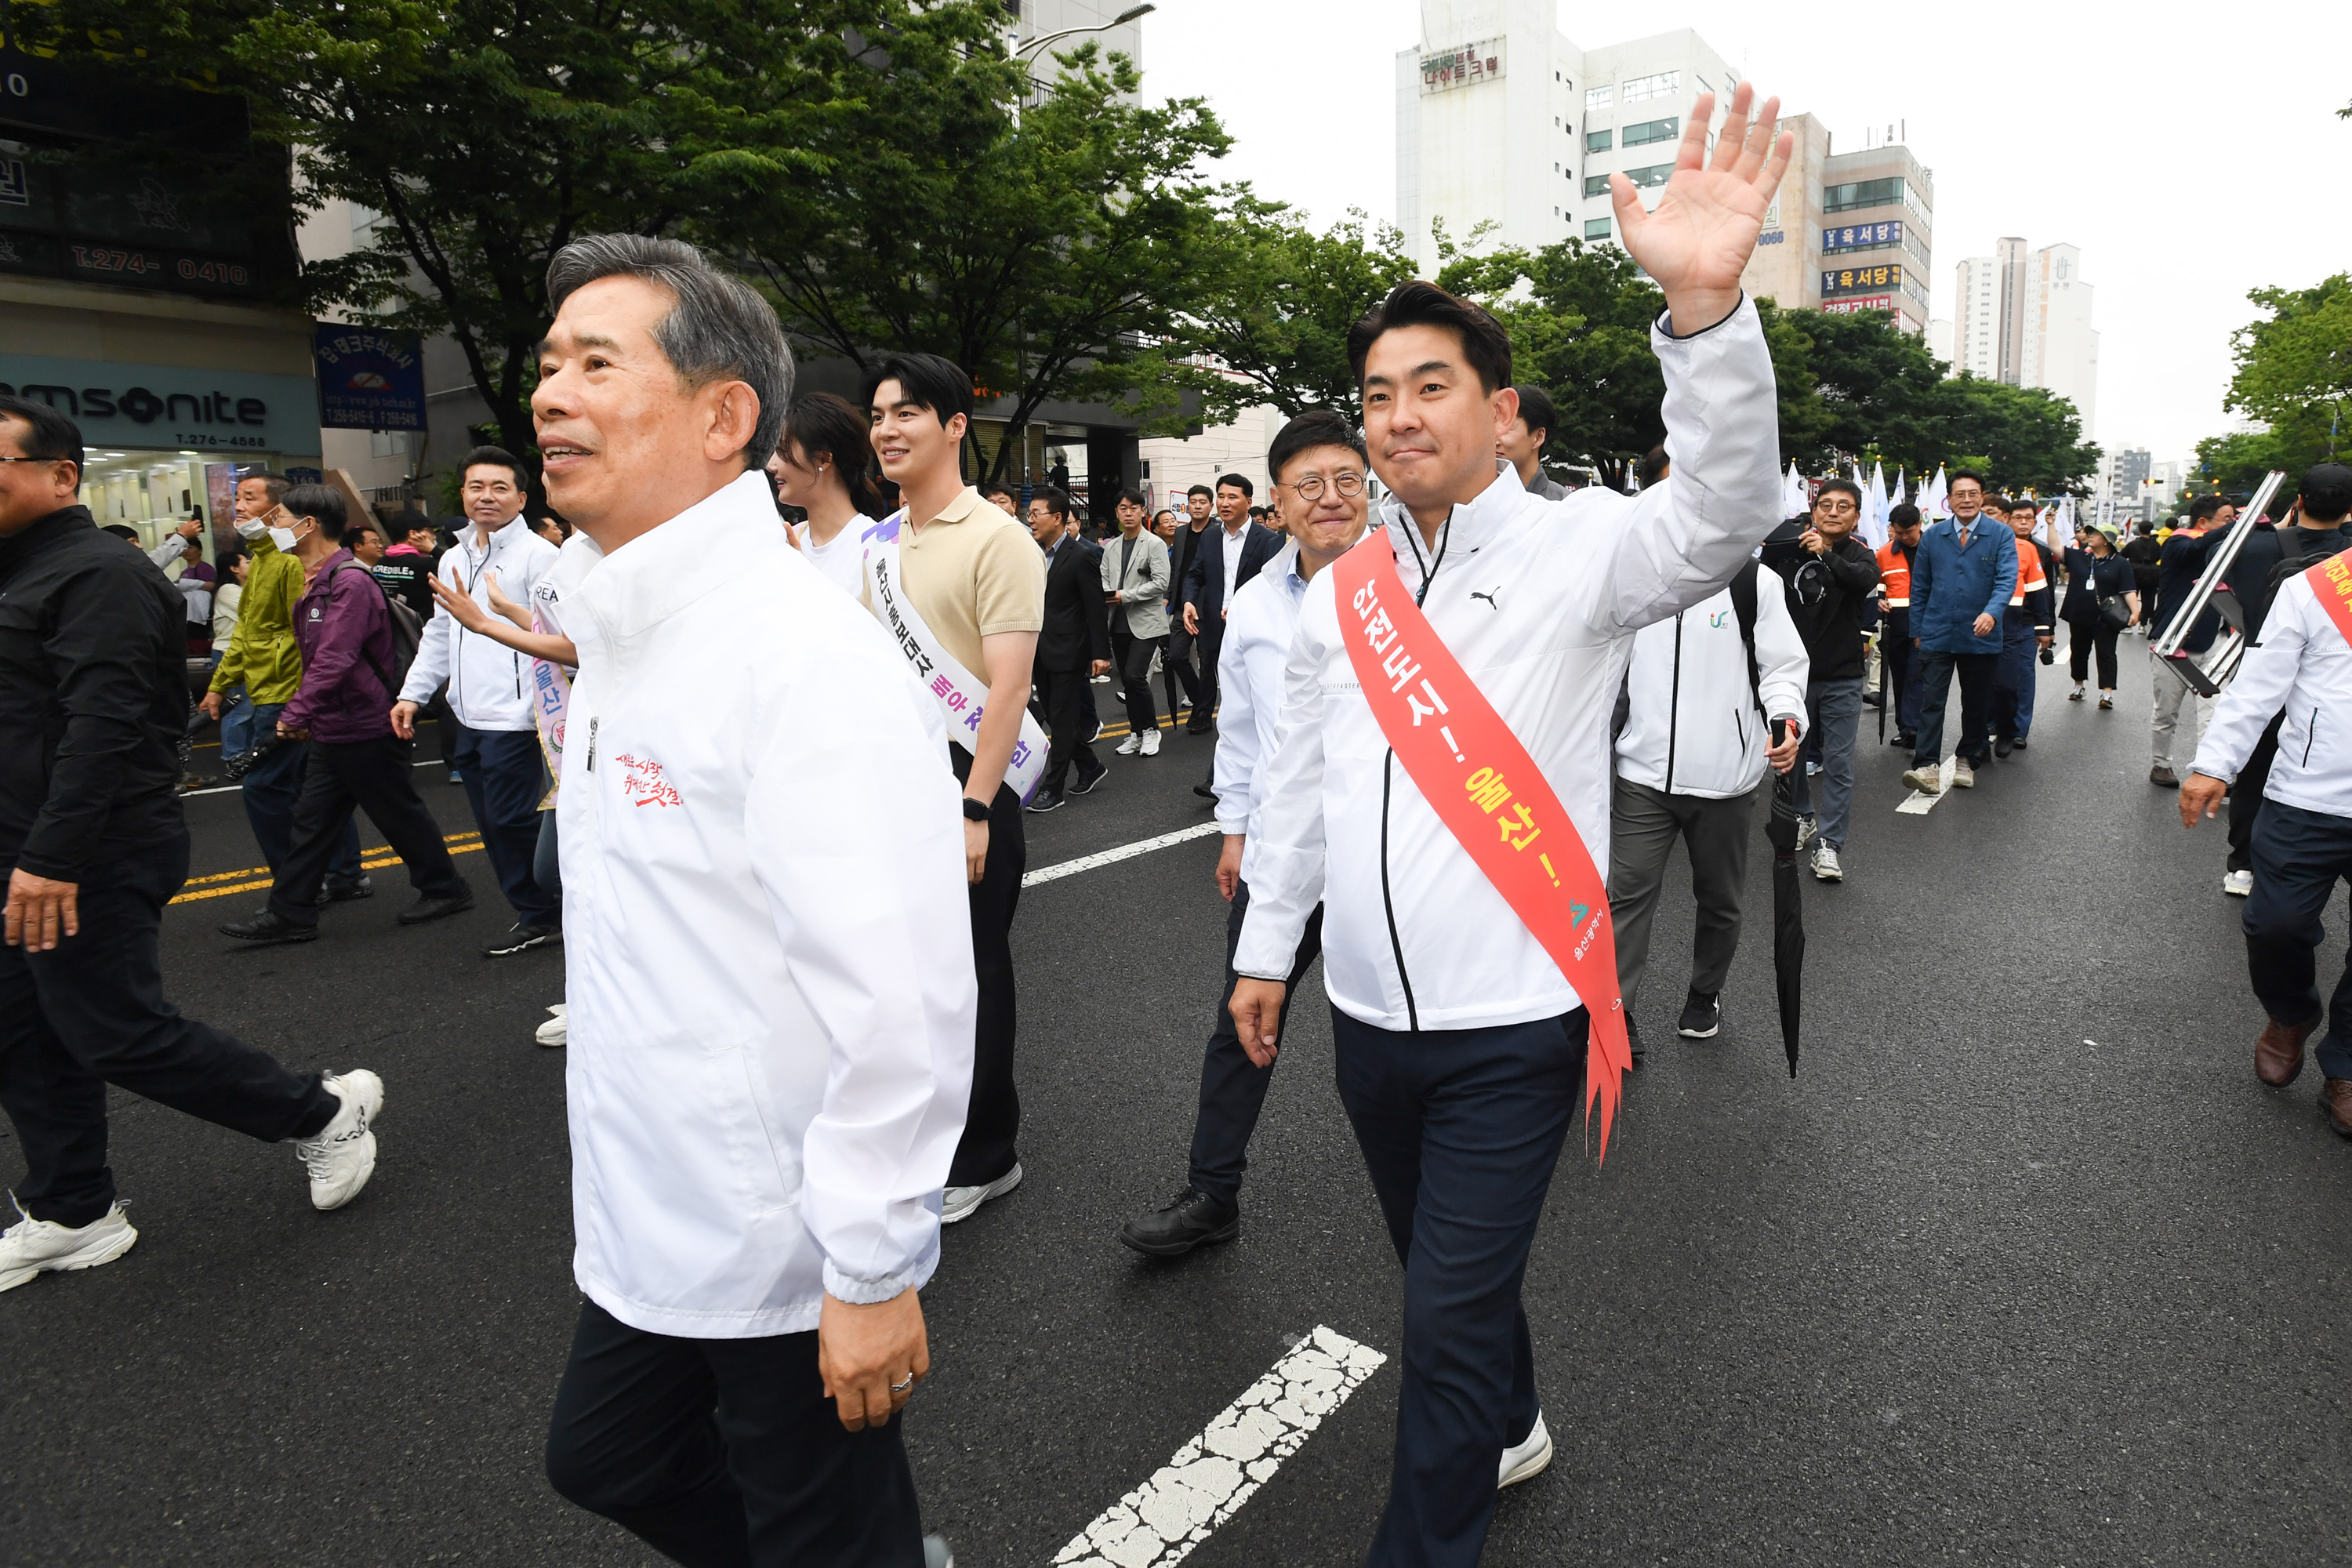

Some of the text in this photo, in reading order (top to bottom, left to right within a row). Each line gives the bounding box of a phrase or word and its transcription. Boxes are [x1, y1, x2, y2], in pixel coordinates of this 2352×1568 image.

[1842, 223, 1889, 244] 육서당
[178, 259, 248, 285] 0410
[1839, 267, 1889, 288] 육서당
[176, 434, 267, 447] T.276-4588
[876, 557, 934, 678] 울산시홍보대사
[930, 673, 968, 713] 배우
[535, 662, 563, 716] 울산
[1352, 579, 1562, 888] 안전도시! 울산!
[1574, 908, 1604, 961] 울산광역시
